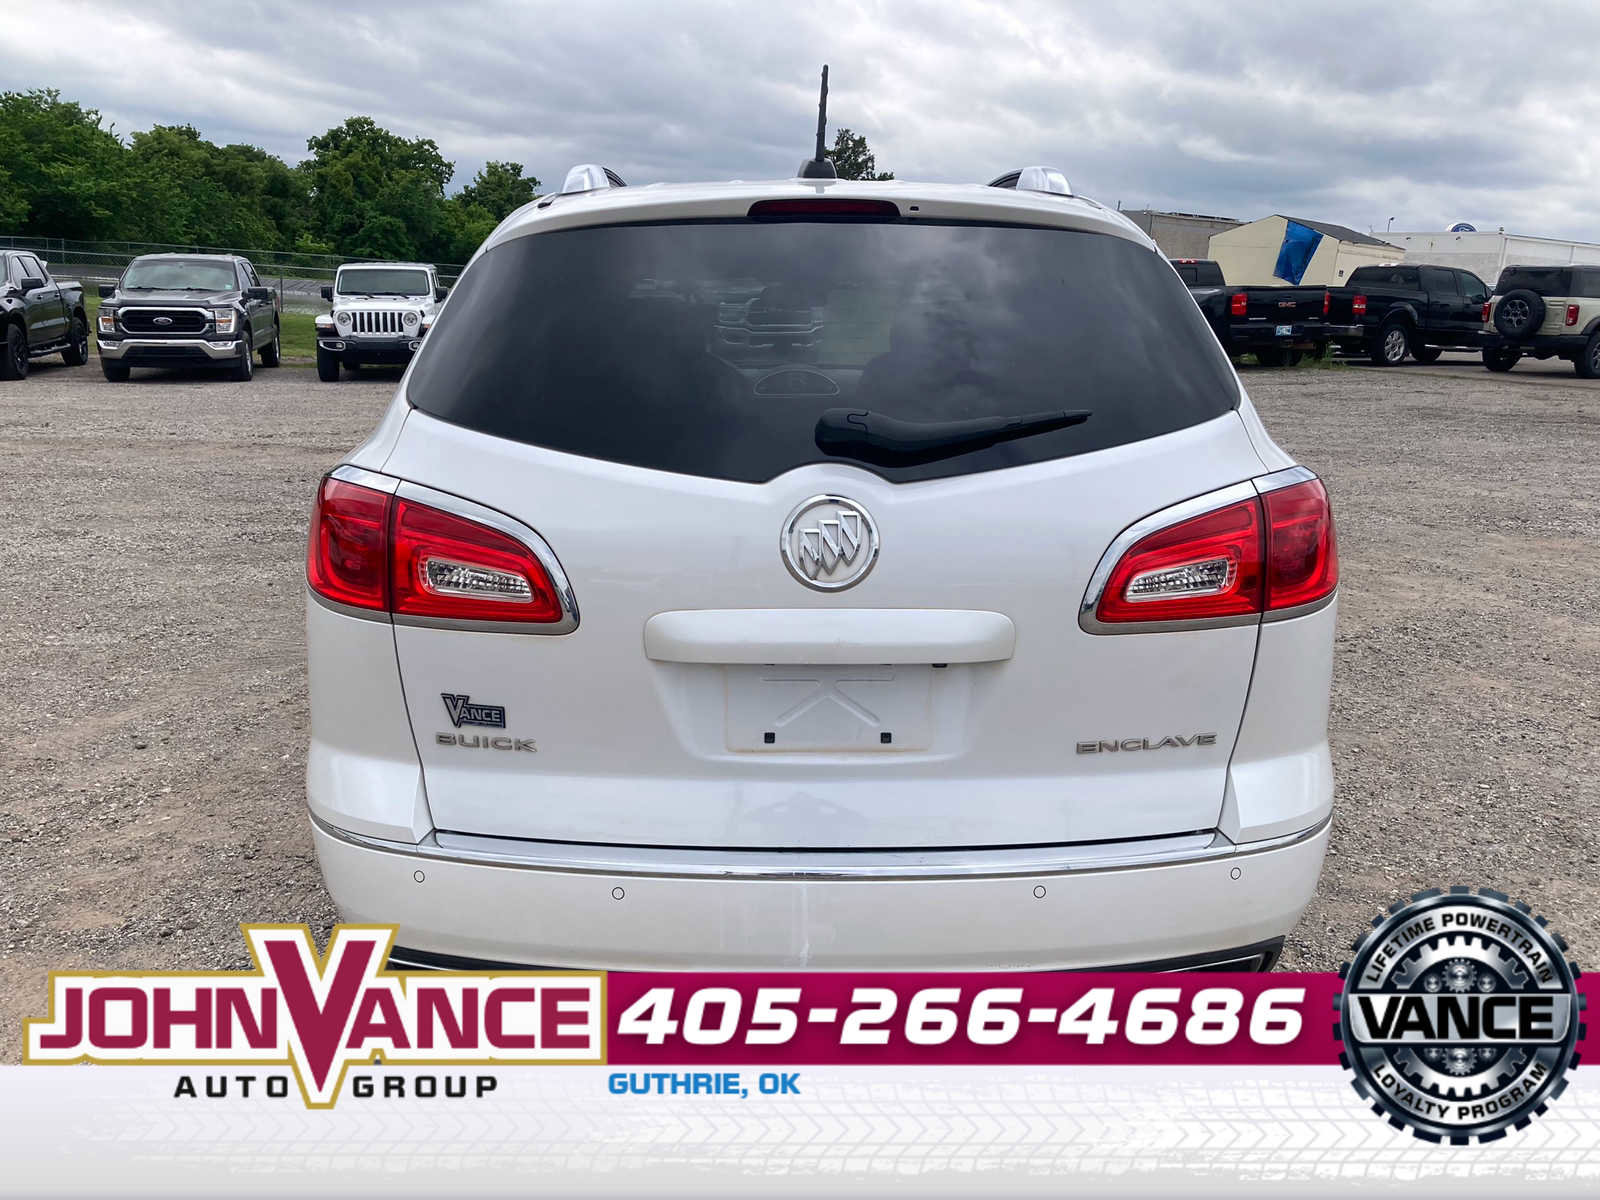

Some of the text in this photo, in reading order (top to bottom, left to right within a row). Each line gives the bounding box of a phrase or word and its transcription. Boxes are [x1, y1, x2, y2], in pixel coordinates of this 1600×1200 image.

[441, 693, 503, 728] VANCE
[436, 732, 538, 752] BUICK
[1076, 732, 1217, 754] ENCLAVE
